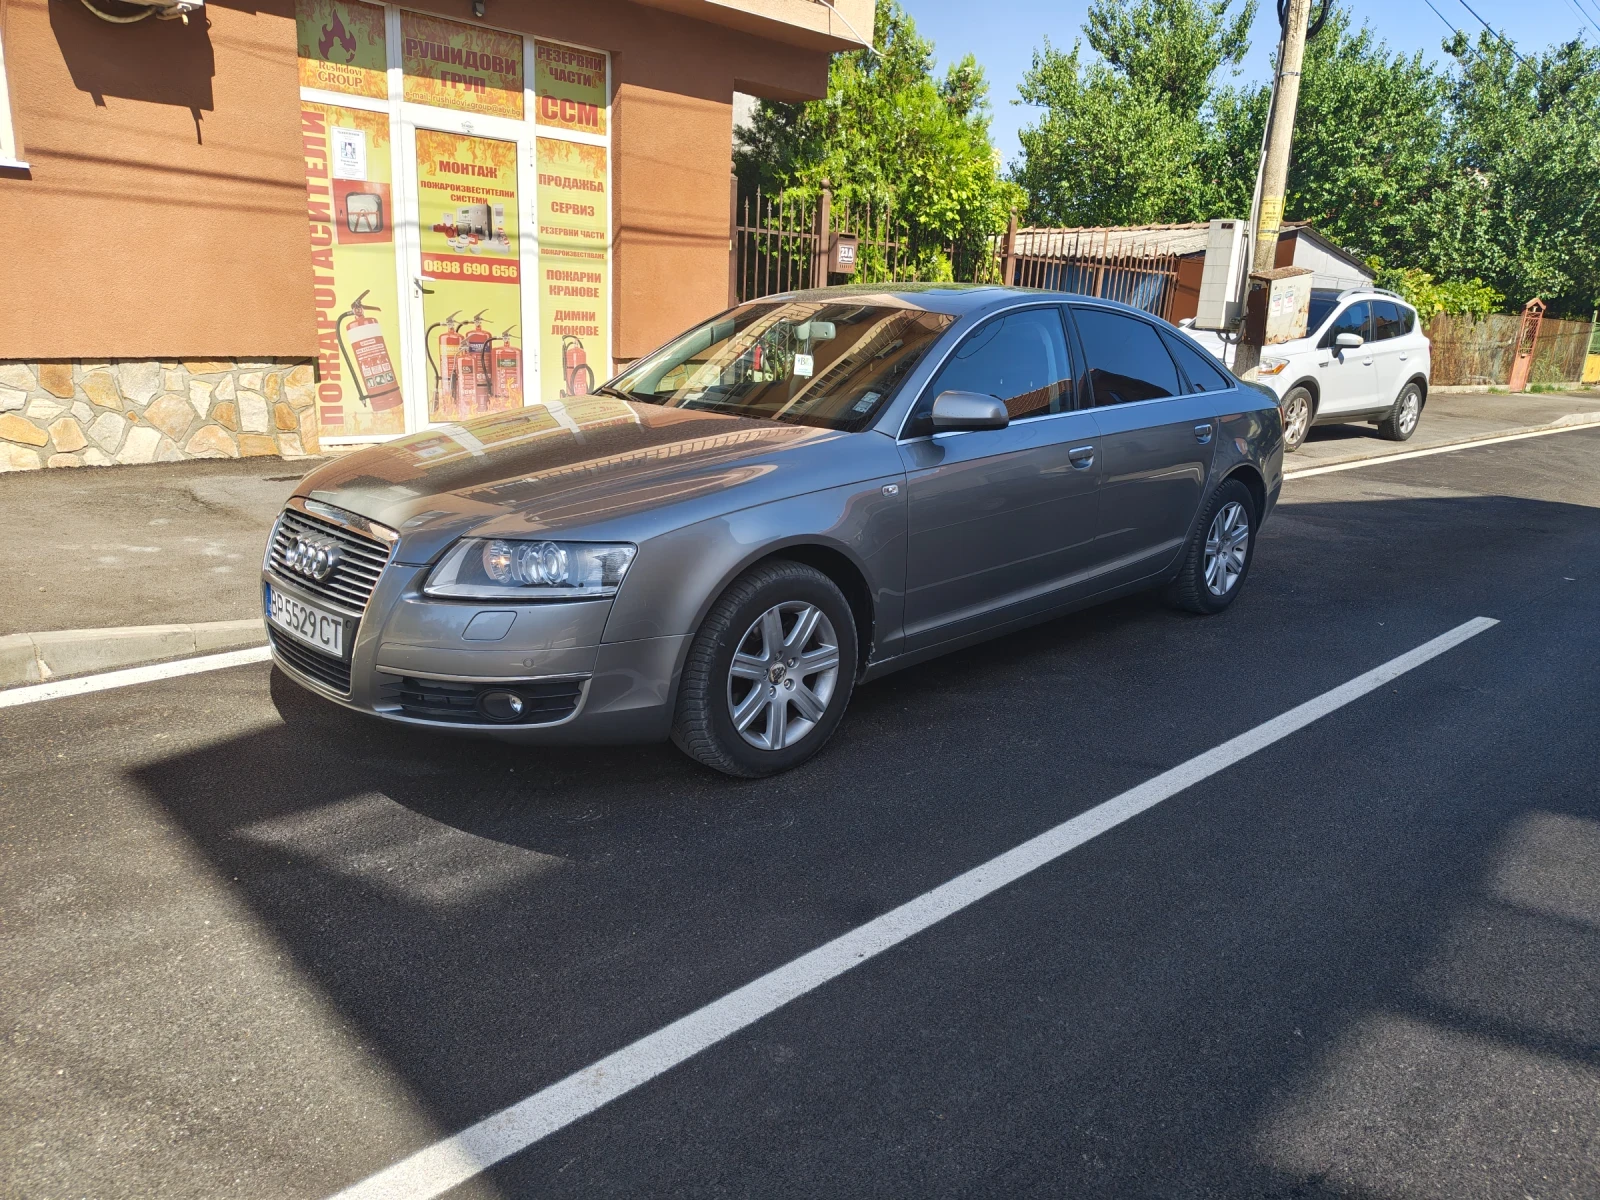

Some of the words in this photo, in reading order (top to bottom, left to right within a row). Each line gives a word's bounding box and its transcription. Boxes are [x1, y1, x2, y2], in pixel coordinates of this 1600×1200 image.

[405, 37, 517, 77] РУШИДОВИ
[537, 45, 602, 71] РЕЗЕРВНИ
[318, 60, 362, 77] Rushidovi
[548, 66, 592, 87] ЧАСТИ
[317, 70, 363, 88] GROUP
[440, 70, 486, 95] ГРУП
[405, 91, 431, 101] e-mail:
[541, 94, 599, 128] ССМ
[438, 159, 498, 179] МОНТАЖ
[420, 180, 516, 199] ПОЖАРОИЗВЕСТИТЕЛНИ
[538, 173, 605, 193] ПРОДАЖБА
[450, 193, 489, 205] СИСТЕМИ
[550, 201, 596, 217] СЕРВИЗ
[540, 225, 579, 237] РЕЗЕРВНИ
[580, 230, 605, 240] ЧАСТИ
[300, 109, 345, 426] ПОЖАРОГАСИТЕЛИ
[423, 259, 460, 274] 0898
[462, 262, 490, 276] 690
[491, 264, 518, 278] 656
[546, 269, 602, 284] ПОЖАРНИ
[548, 284, 600, 298] КРАНОВЕ
[554, 309, 596, 323] ДИМНИ
[551, 324, 599, 336] ЛЮКОВЕ
[285, 598, 317, 640] 5529
[320, 615, 342, 650] CT
